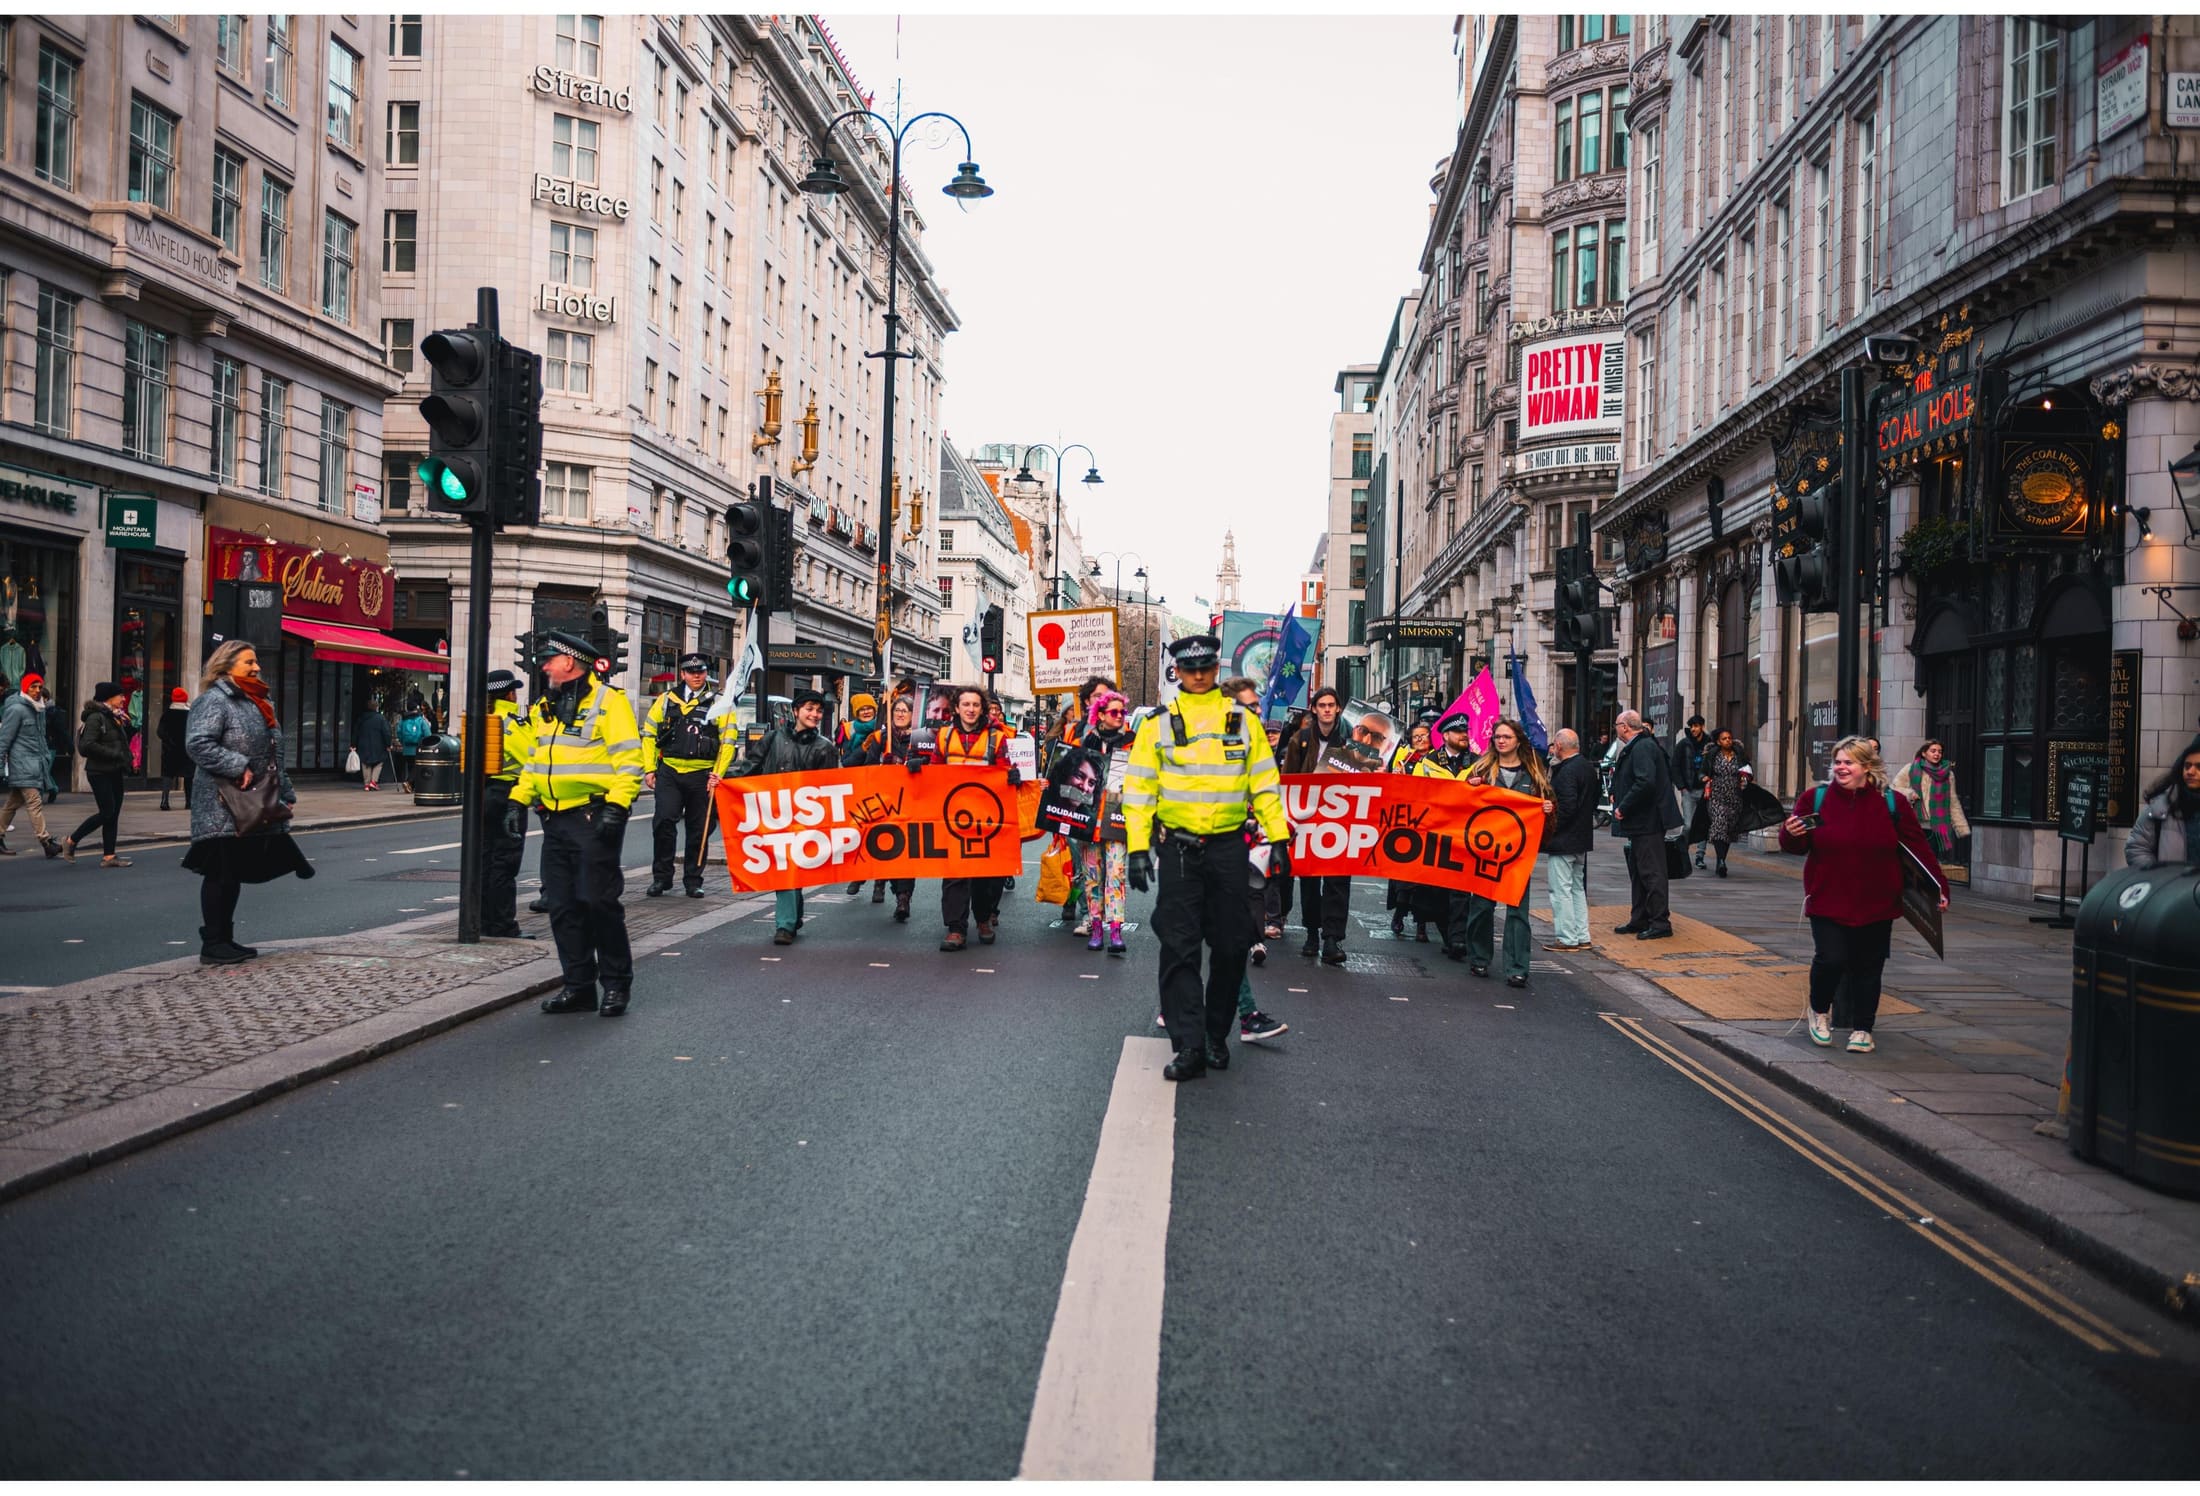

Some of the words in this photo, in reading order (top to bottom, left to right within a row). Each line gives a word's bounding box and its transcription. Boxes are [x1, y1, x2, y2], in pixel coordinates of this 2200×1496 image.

[533, 64, 633, 113] Strand
[2101, 67, 2126, 94] STRAND
[533, 172, 631, 220] Palace
[134, 223, 190, 266] MANFIELD
[193, 250, 229, 285] HOUSE
[539, 284, 618, 324] Hotel
[1512, 315, 1560, 340] SAVOY
[1527, 343, 1603, 391] PRETTY
[1603, 340, 1625, 394] MUSICAL
[1914, 370, 1933, 395] THE
[1527, 385, 1600, 427] WOMAN
[1602, 395, 1622, 418] THE
[1879, 407, 1921, 452] COAL
[1928, 383, 1972, 432] HOLE
[1535, 450, 1554, 468] NIGHT
[1555, 449, 1571, 465] OUT.
[1574, 447, 1591, 463] BIG.
[1594, 445, 1619, 462] HUGE.
[2016, 455, 2033, 472] THE
[2032, 449, 2058, 461] COAL
[2058, 452, 2080, 474] HOLE
[112, 525, 148, 533] MOUNTAIN
[2025, 515, 2061, 526] STRAND
[282, 554, 345, 608] Salieri
[1071, 614, 1105, 631] political
[1399, 627, 1454, 637] SIMPSON'S
[1066, 641, 1081, 652] held
[1068, 629, 1106, 643] prisoners
[790, 651, 817, 660] PALACE
[737, 784, 853, 833] JUST
[849, 787, 904, 828] NEW
[1046, 805, 1090, 823] SOLIDARITY
[1379, 804, 1429, 829] NEW
[742, 827, 861, 874] STOP
[866, 822, 948, 861] OIL
[1294, 822, 1380, 859] TOP
[1383, 828, 1464, 872] OIL
